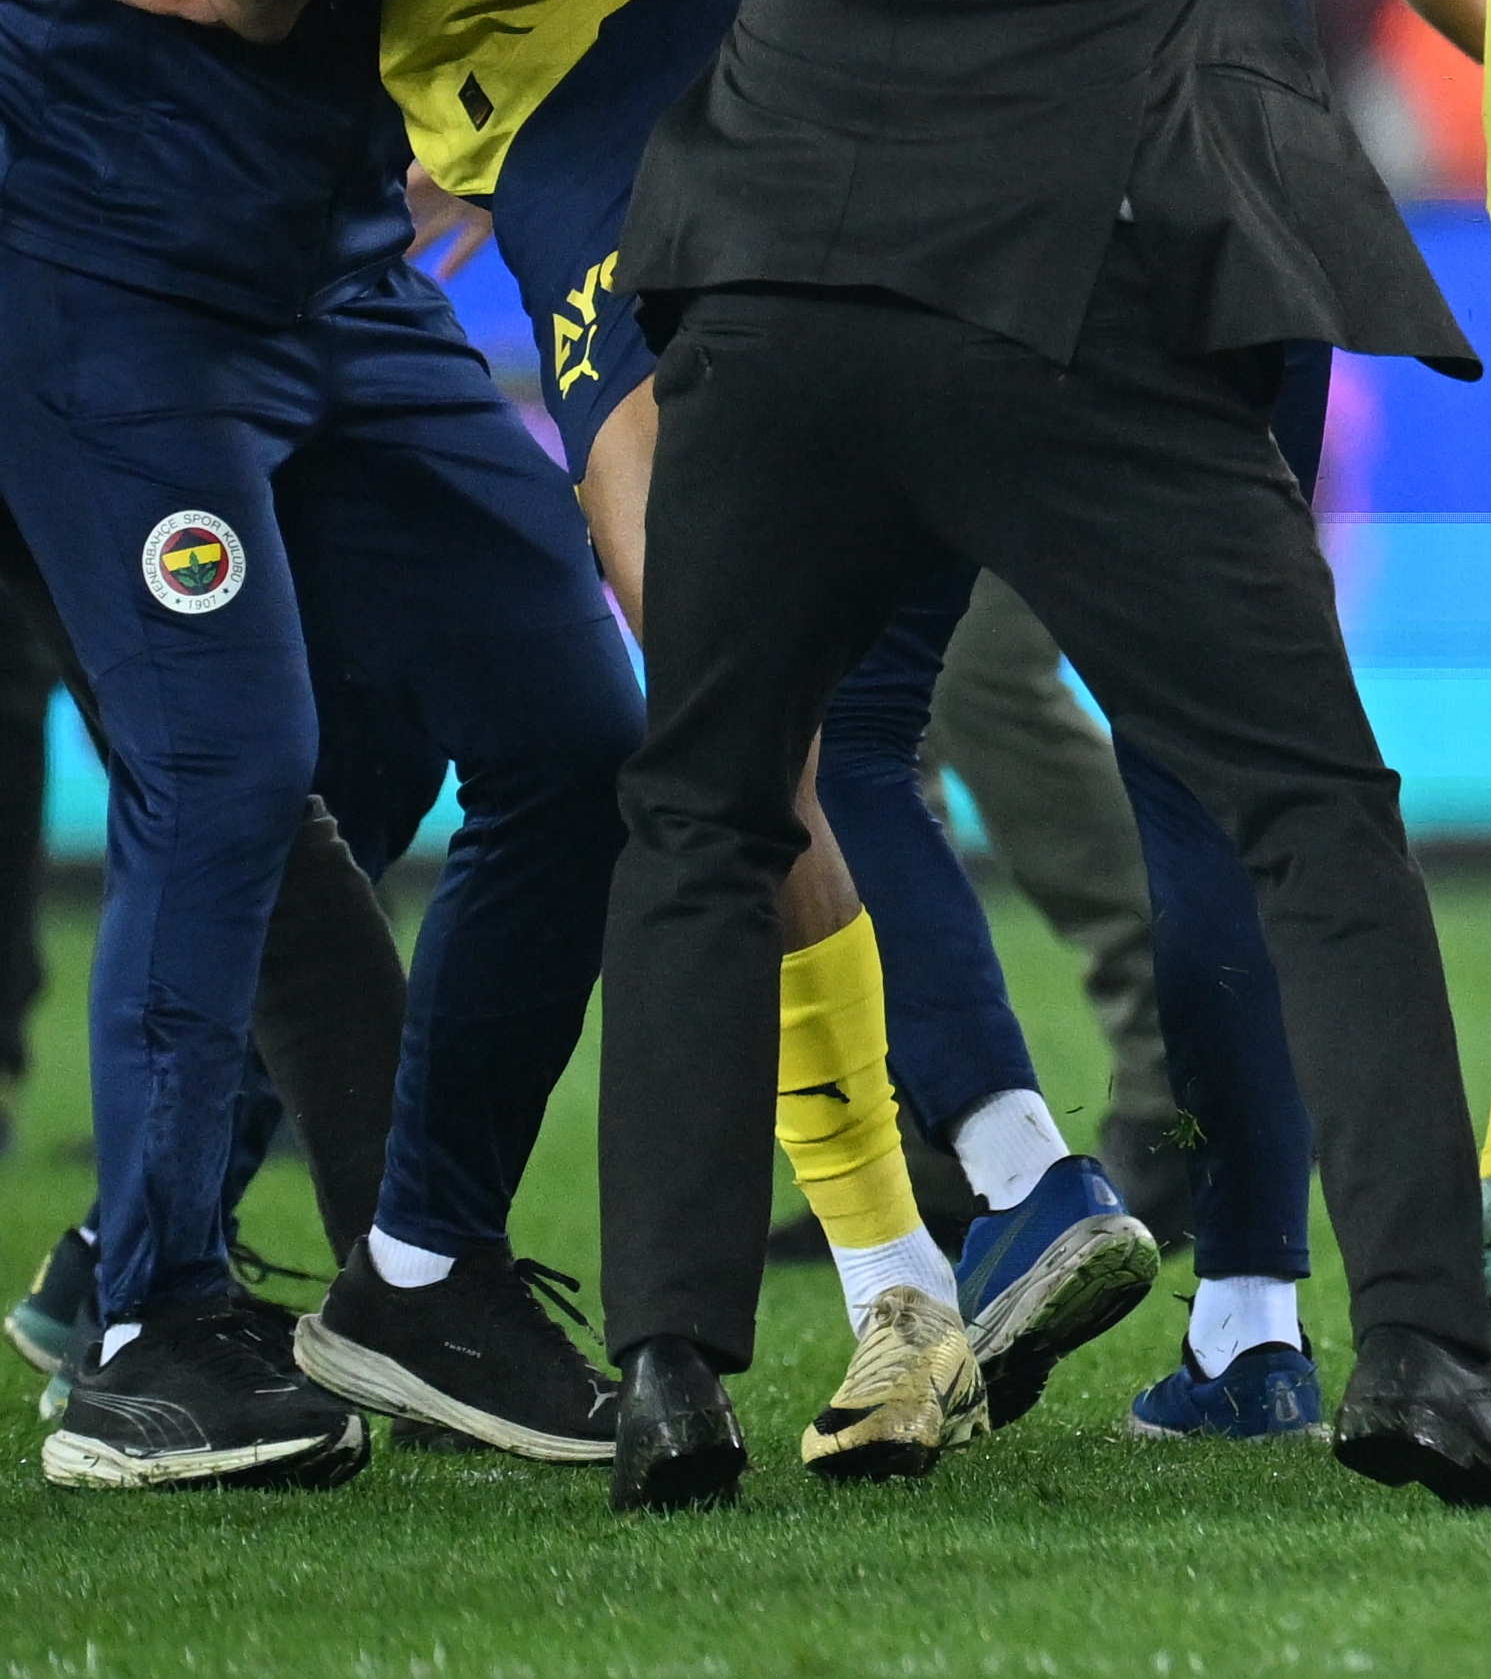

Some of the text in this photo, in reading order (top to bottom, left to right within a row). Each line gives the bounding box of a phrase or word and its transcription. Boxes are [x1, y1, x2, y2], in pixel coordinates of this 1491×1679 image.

[145, 518, 178, 600] FENERBAHÇE
[183, 513, 222, 532] SPOR
[188, 594, 218, 610] 1907
